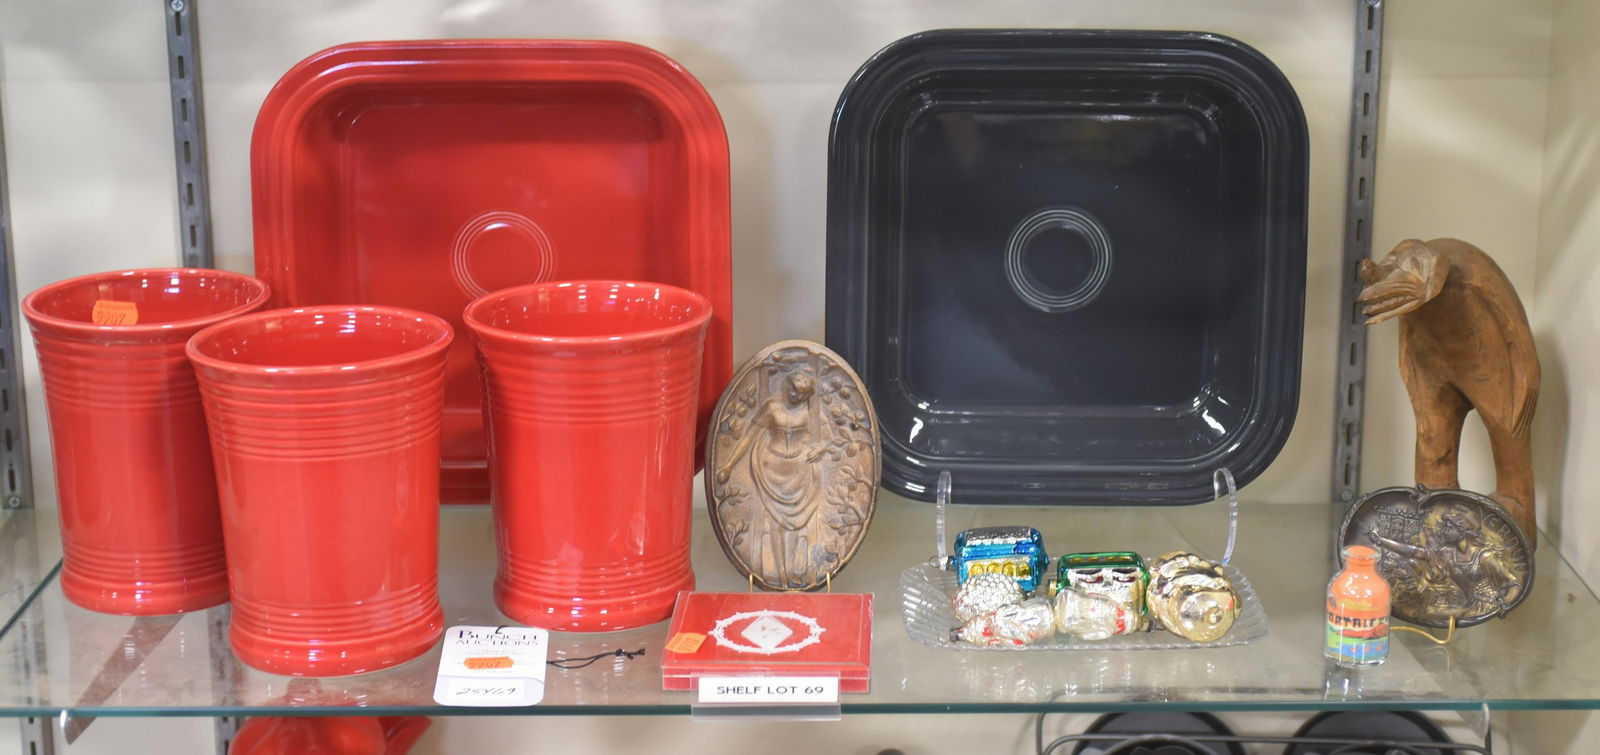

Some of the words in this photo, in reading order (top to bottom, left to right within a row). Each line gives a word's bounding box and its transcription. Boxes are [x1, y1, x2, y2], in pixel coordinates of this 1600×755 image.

[1479, 506, 1528, 575] VERDUN
[458, 630, 538, 640] BUNCH
[716, 686, 762, 695] SHELF
[767, 686, 798, 695] LOT
[804, 686, 825, 695] 69
